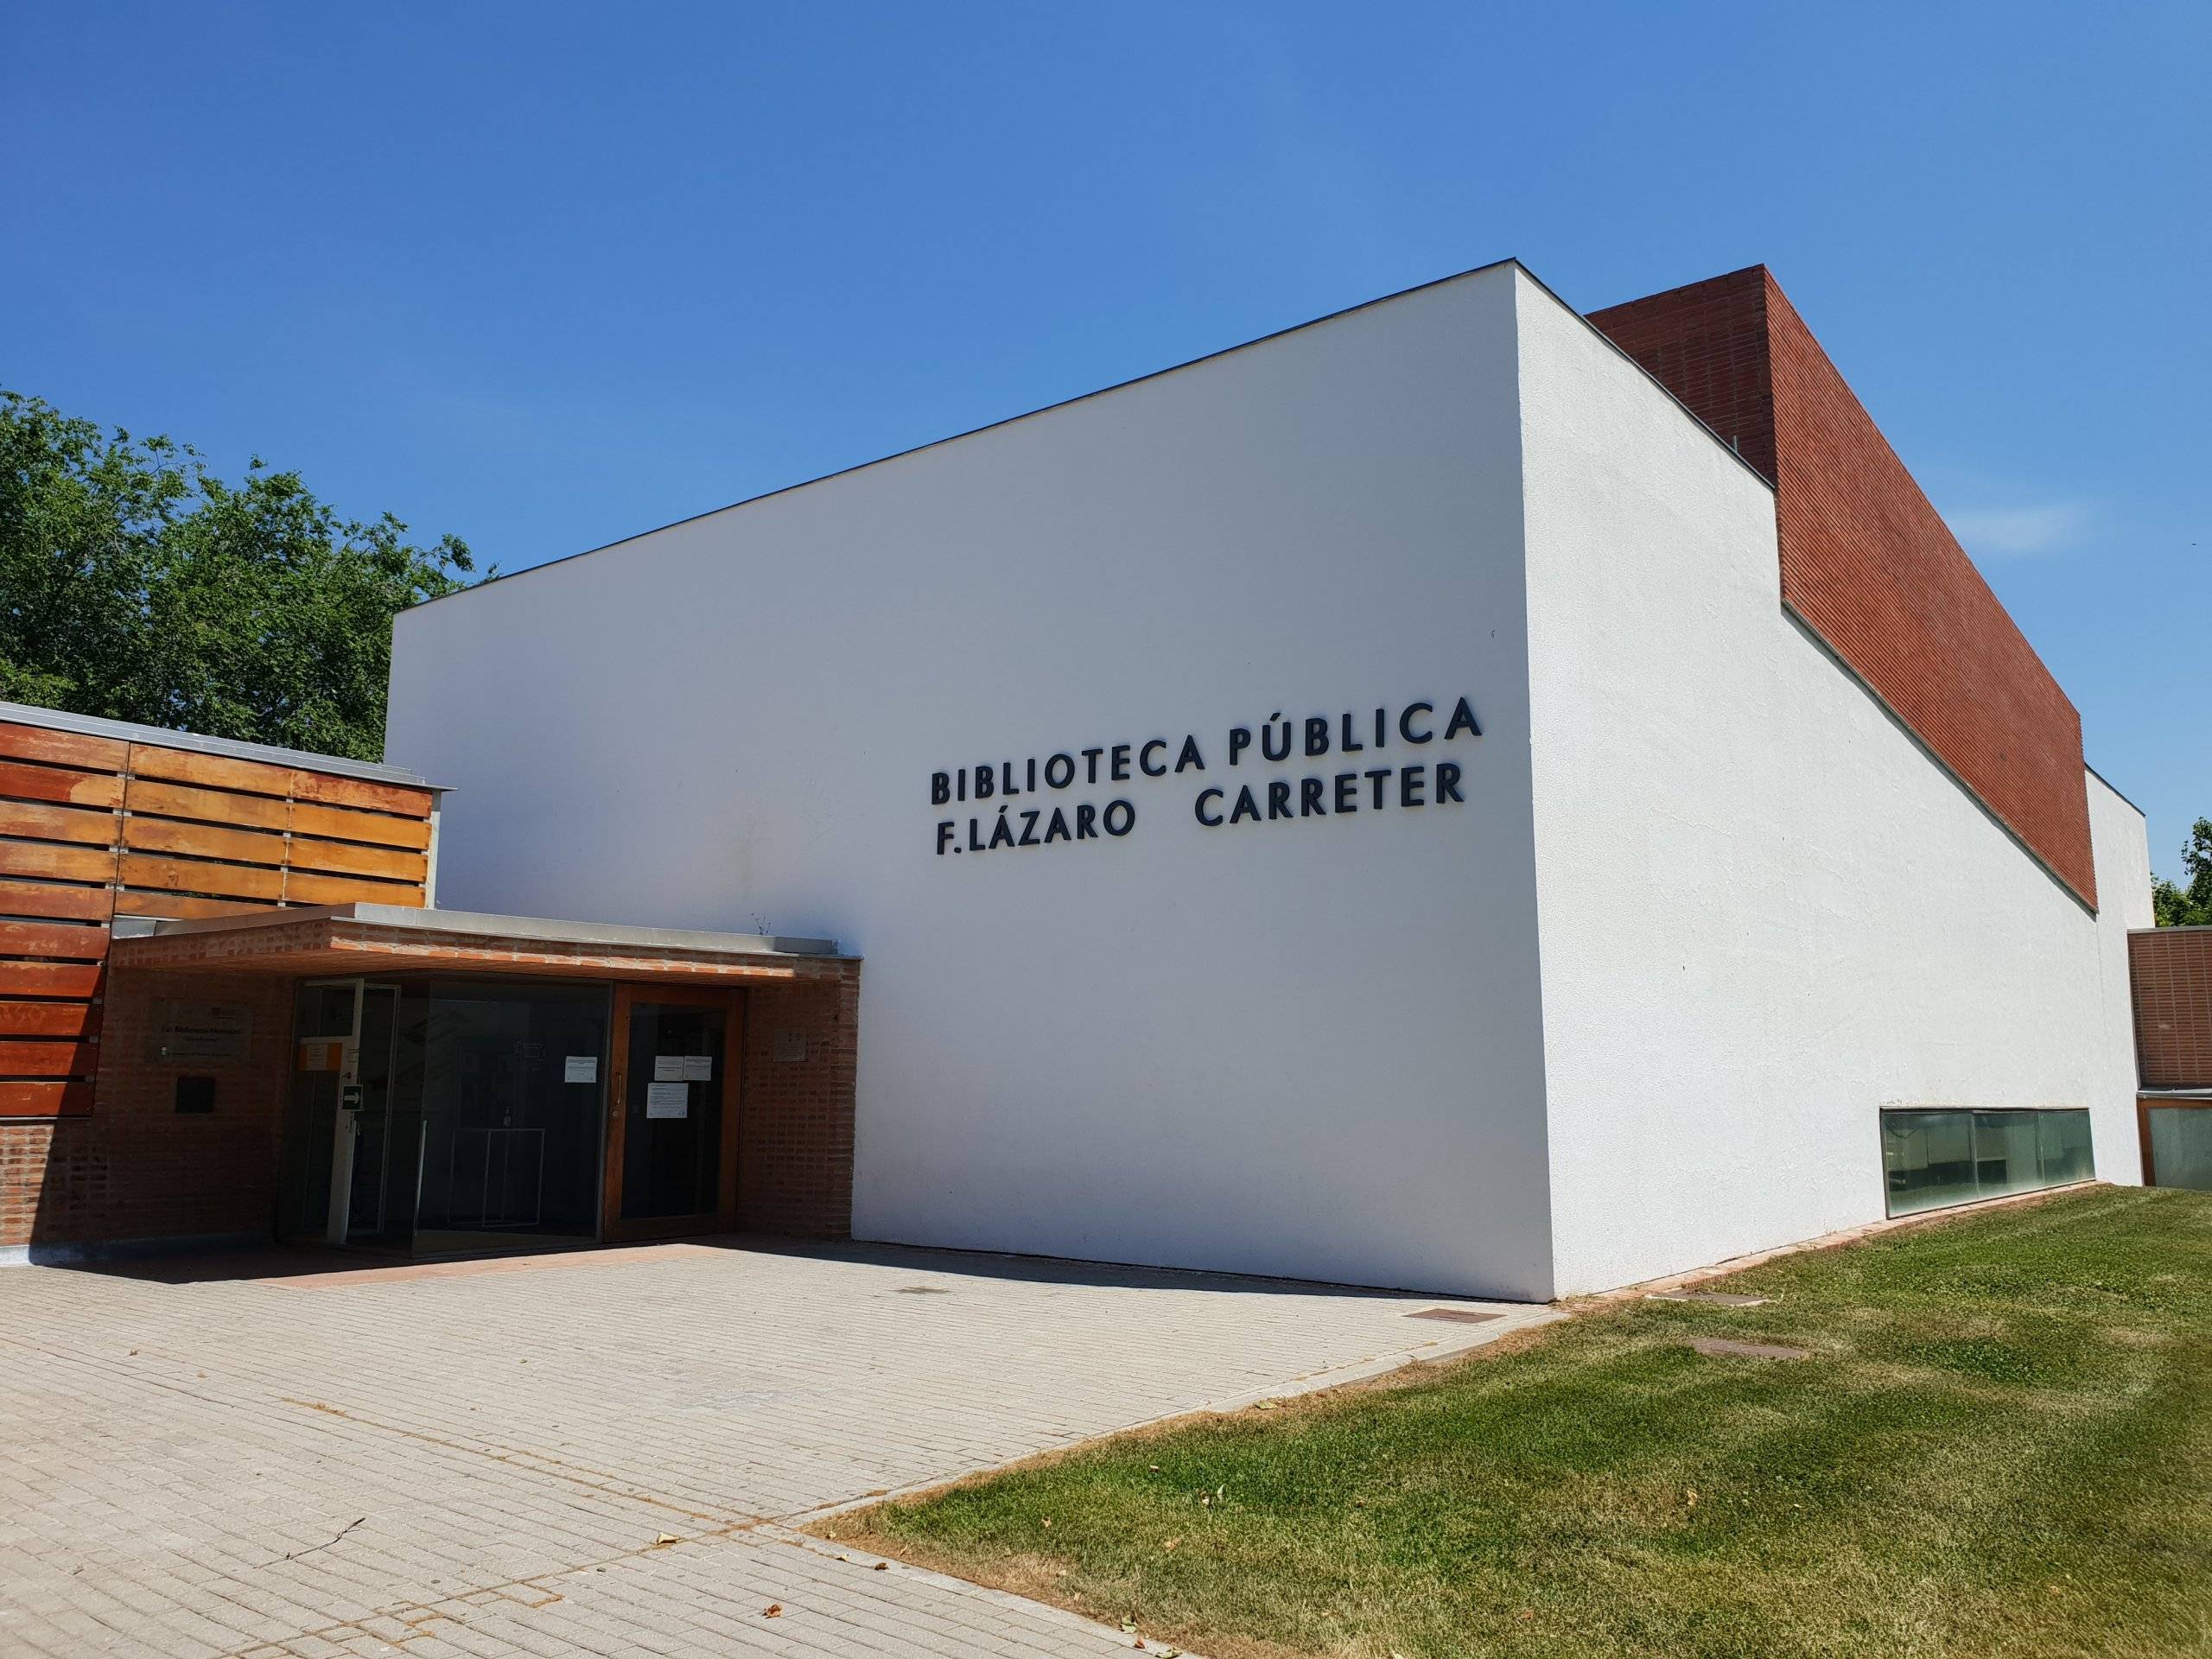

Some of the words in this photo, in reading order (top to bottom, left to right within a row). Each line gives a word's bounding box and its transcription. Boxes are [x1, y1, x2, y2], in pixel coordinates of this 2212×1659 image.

[931, 734, 1205, 804] BIBLIOTECA
[1229, 696, 1483, 766] PÚBLICA
[1194, 762, 1465, 827] CARRETER
